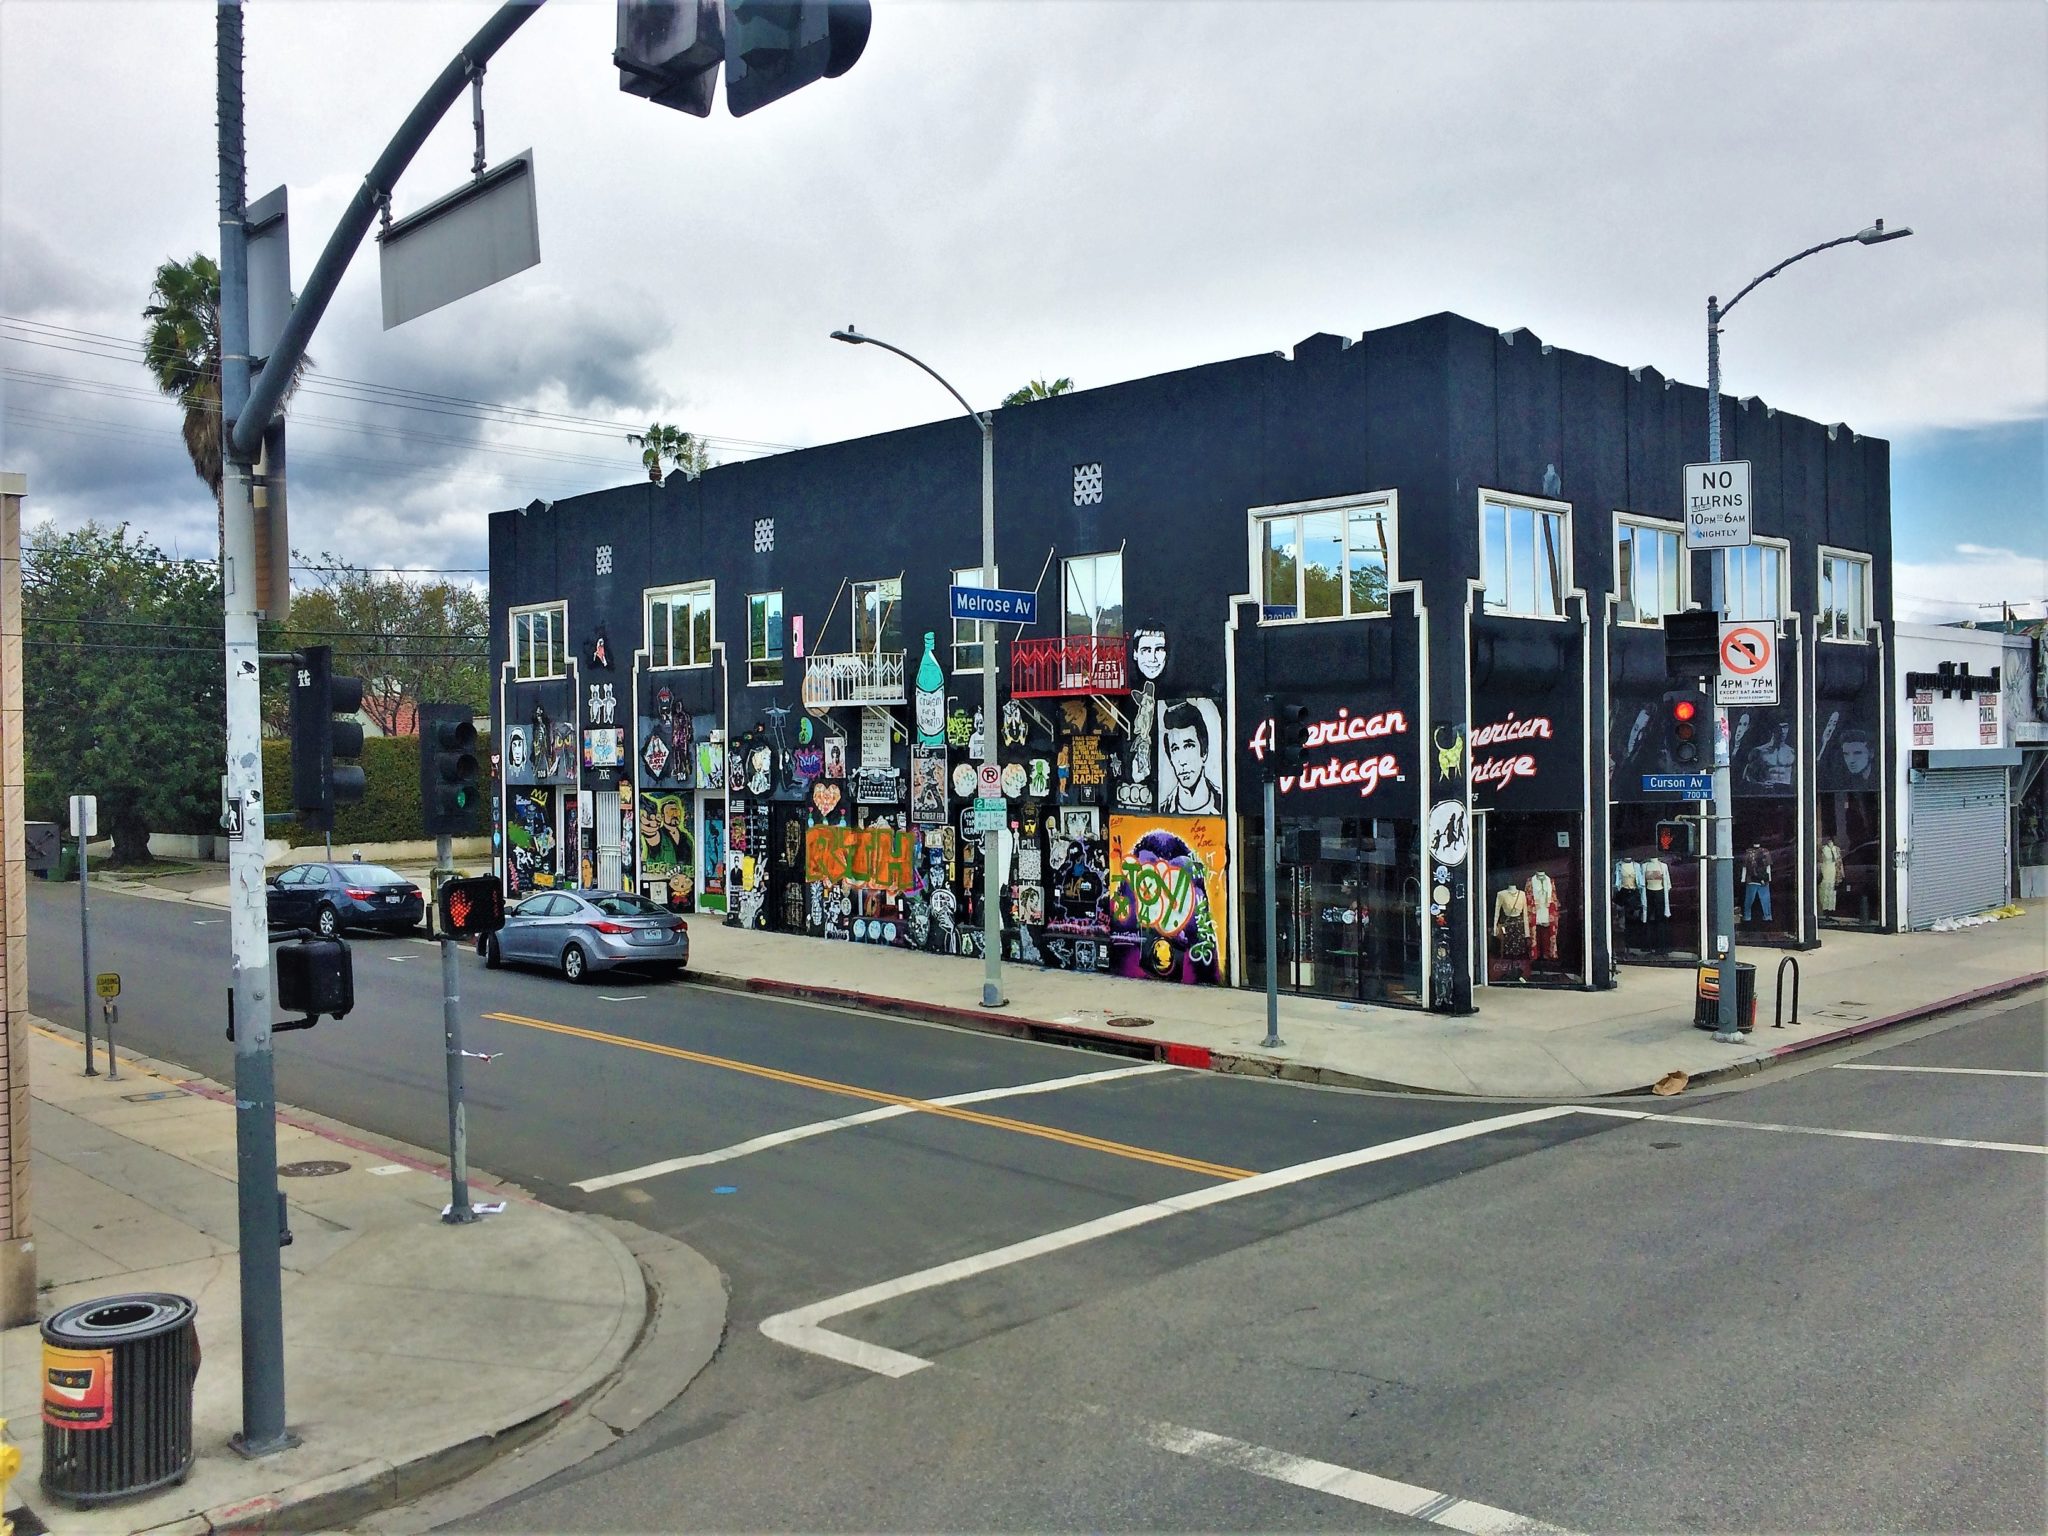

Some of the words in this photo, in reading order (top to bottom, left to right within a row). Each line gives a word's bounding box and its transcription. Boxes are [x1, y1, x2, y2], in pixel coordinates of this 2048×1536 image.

[1702, 471, 1732, 489] NO
[1691, 494, 1742, 508] TURNS
[1690, 514, 1716, 524] 10PM
[1724, 512, 1746, 523] 6AM
[1699, 529, 1738, 538] NIGHTLY
[957, 592, 1010, 613] Melrose
[1015, 598, 1031, 615] Av
[1720, 680, 1742, 688] 4PM
[1751, 678, 1772, 688] 7PM
[1250, 706, 1408, 761] Aerican
[916, 749, 930, 758] TCF
[1073, 775, 1105, 784] RAPIST
[1650, 777, 1685, 788] Curson
[1690, 777, 1703, 788] Av
